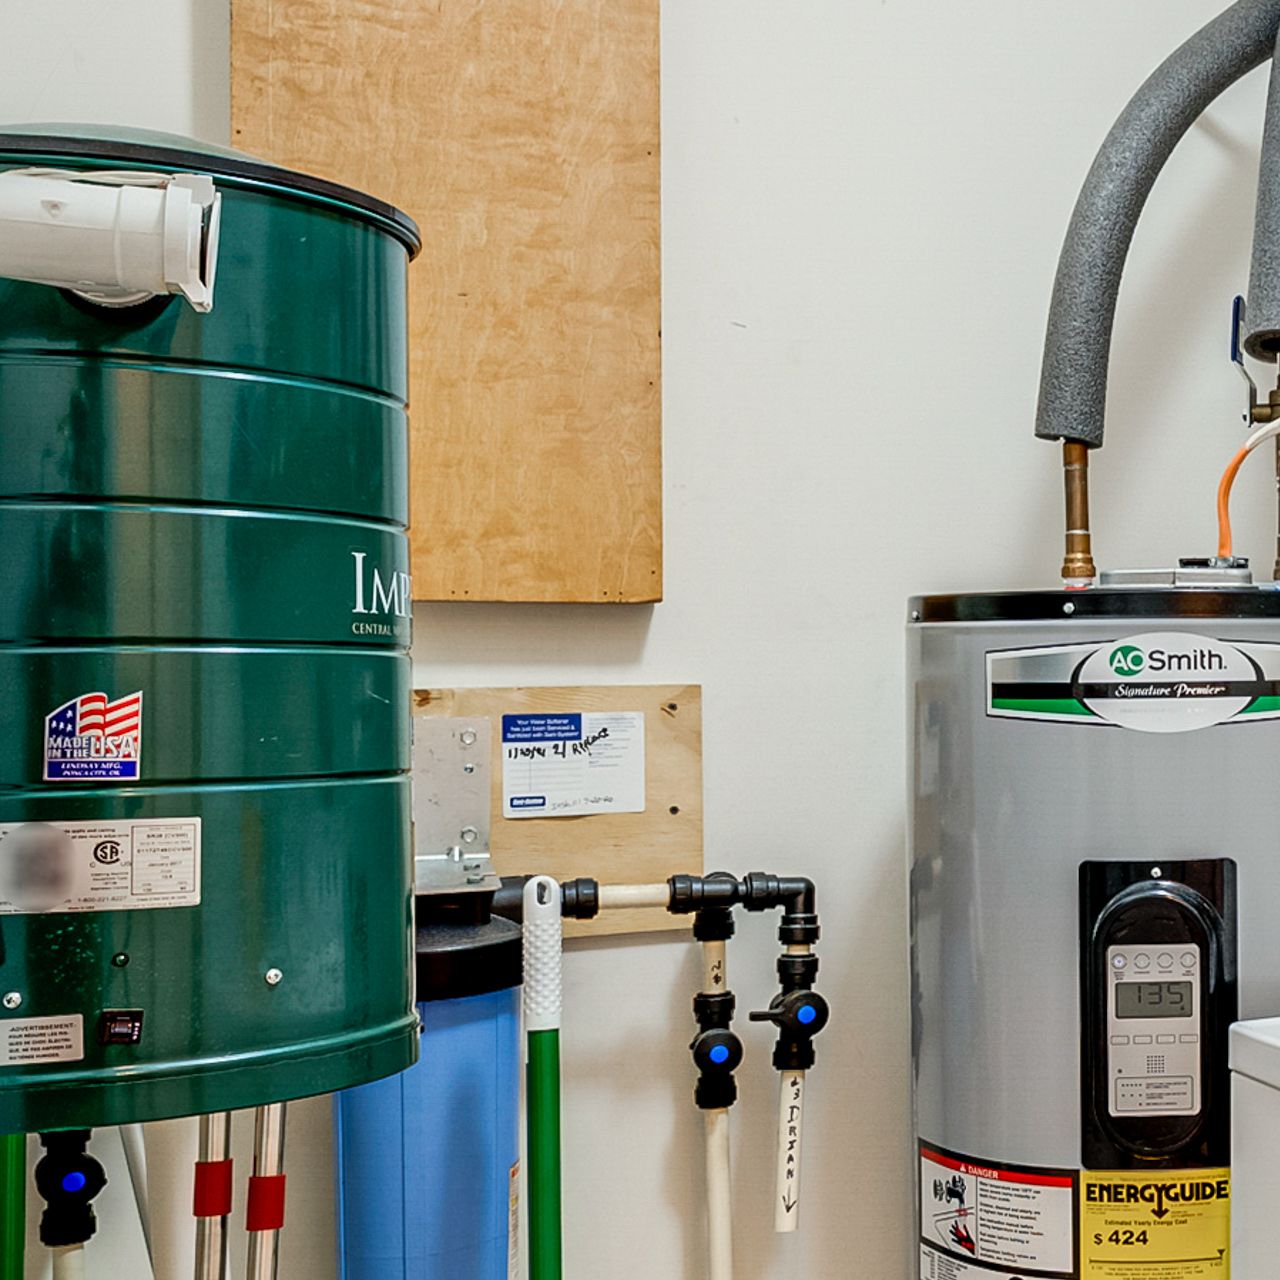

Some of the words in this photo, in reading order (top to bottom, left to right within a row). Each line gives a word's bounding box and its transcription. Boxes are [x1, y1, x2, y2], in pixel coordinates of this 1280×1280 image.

[351, 552, 413, 618] IMP
[352, 622, 392, 636] CENTRAL
[1115, 684, 1171, 698] Signature
[1173, 683, 1223, 698] Premier
[48, 736, 89, 748] MADE
[90, 736, 136, 758] USA
[48, 749, 61, 758] IN
[65, 749, 89, 758] THE
[1138, 984, 1183, 1005] 135
[968, 1166, 999, 1179] DANGER
[1086, 1180, 1229, 1203] ENERGYGUIDE
[1093, 1233, 1103, 1245] $
[1108, 1229, 1149, 1245] 424
